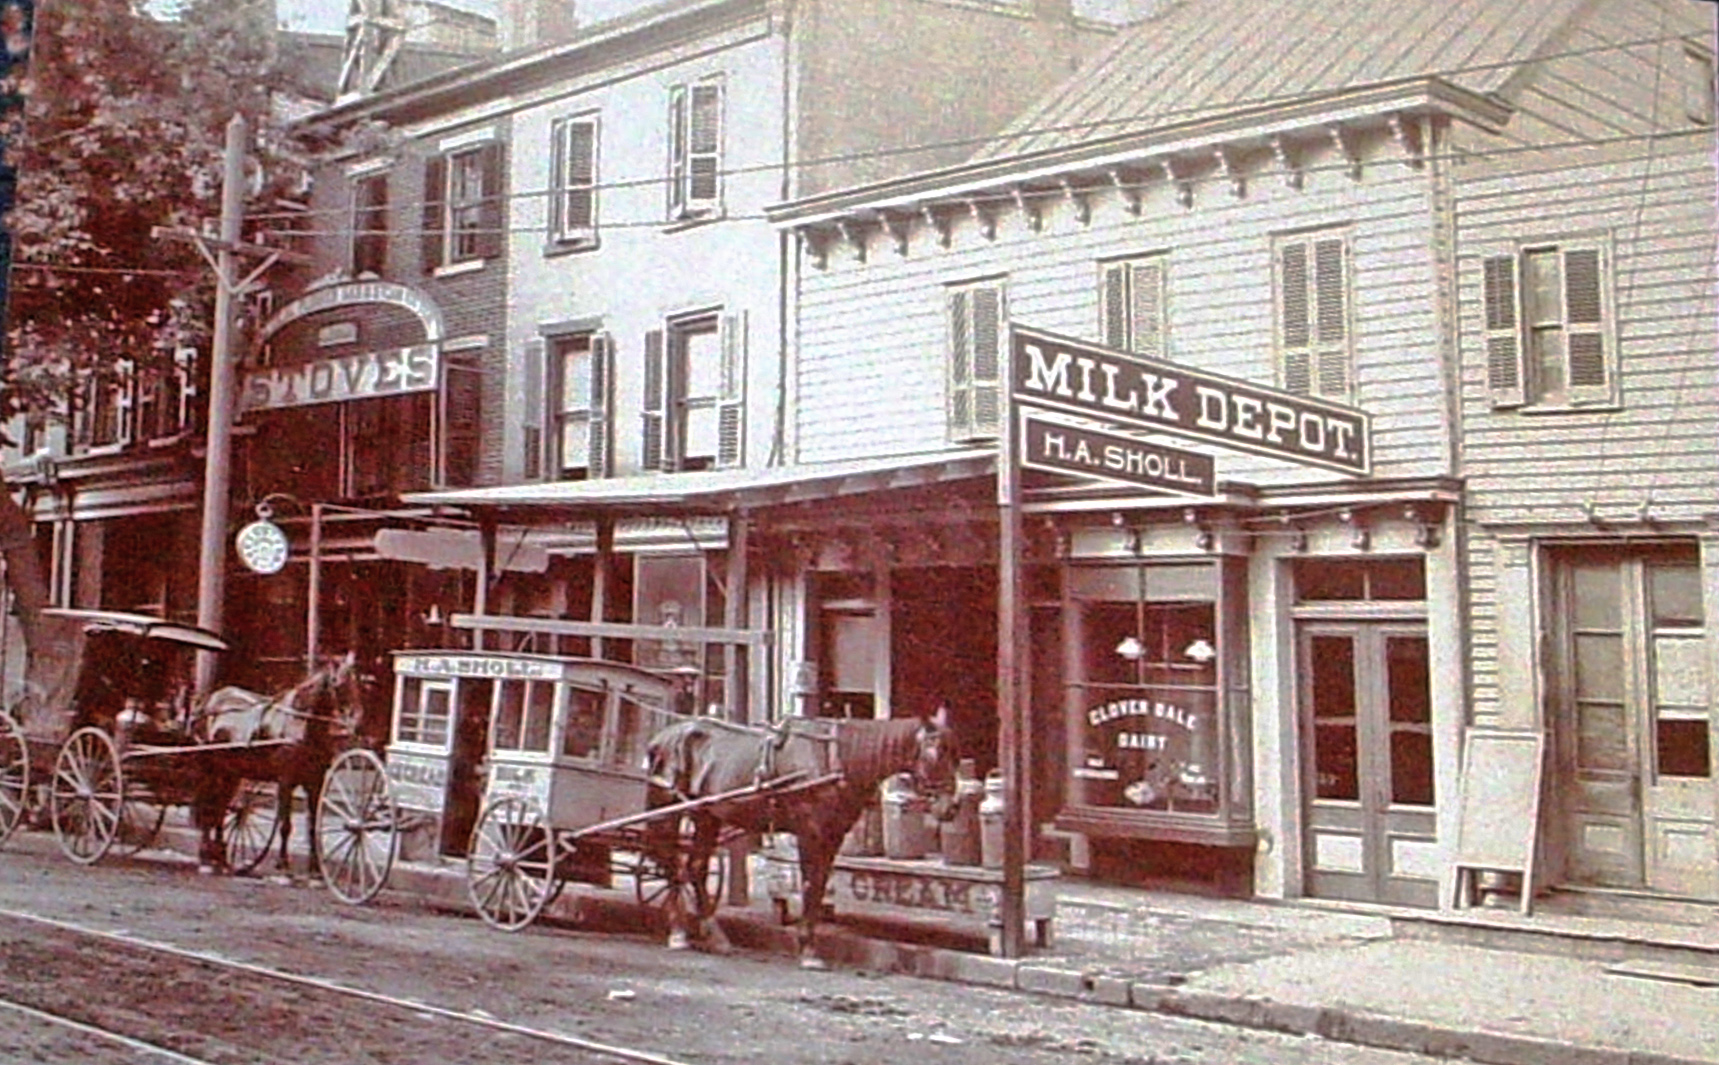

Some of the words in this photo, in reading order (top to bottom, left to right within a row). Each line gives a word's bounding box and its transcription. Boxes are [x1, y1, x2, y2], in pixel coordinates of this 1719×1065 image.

[250, 347, 431, 401] STOVES
[1024, 345, 1180, 420] MILK
[1196, 386, 1357, 460] DEPOT.
[1088, 699, 1149, 726] CLOVER
[1154, 702, 1197, 730] DALE
